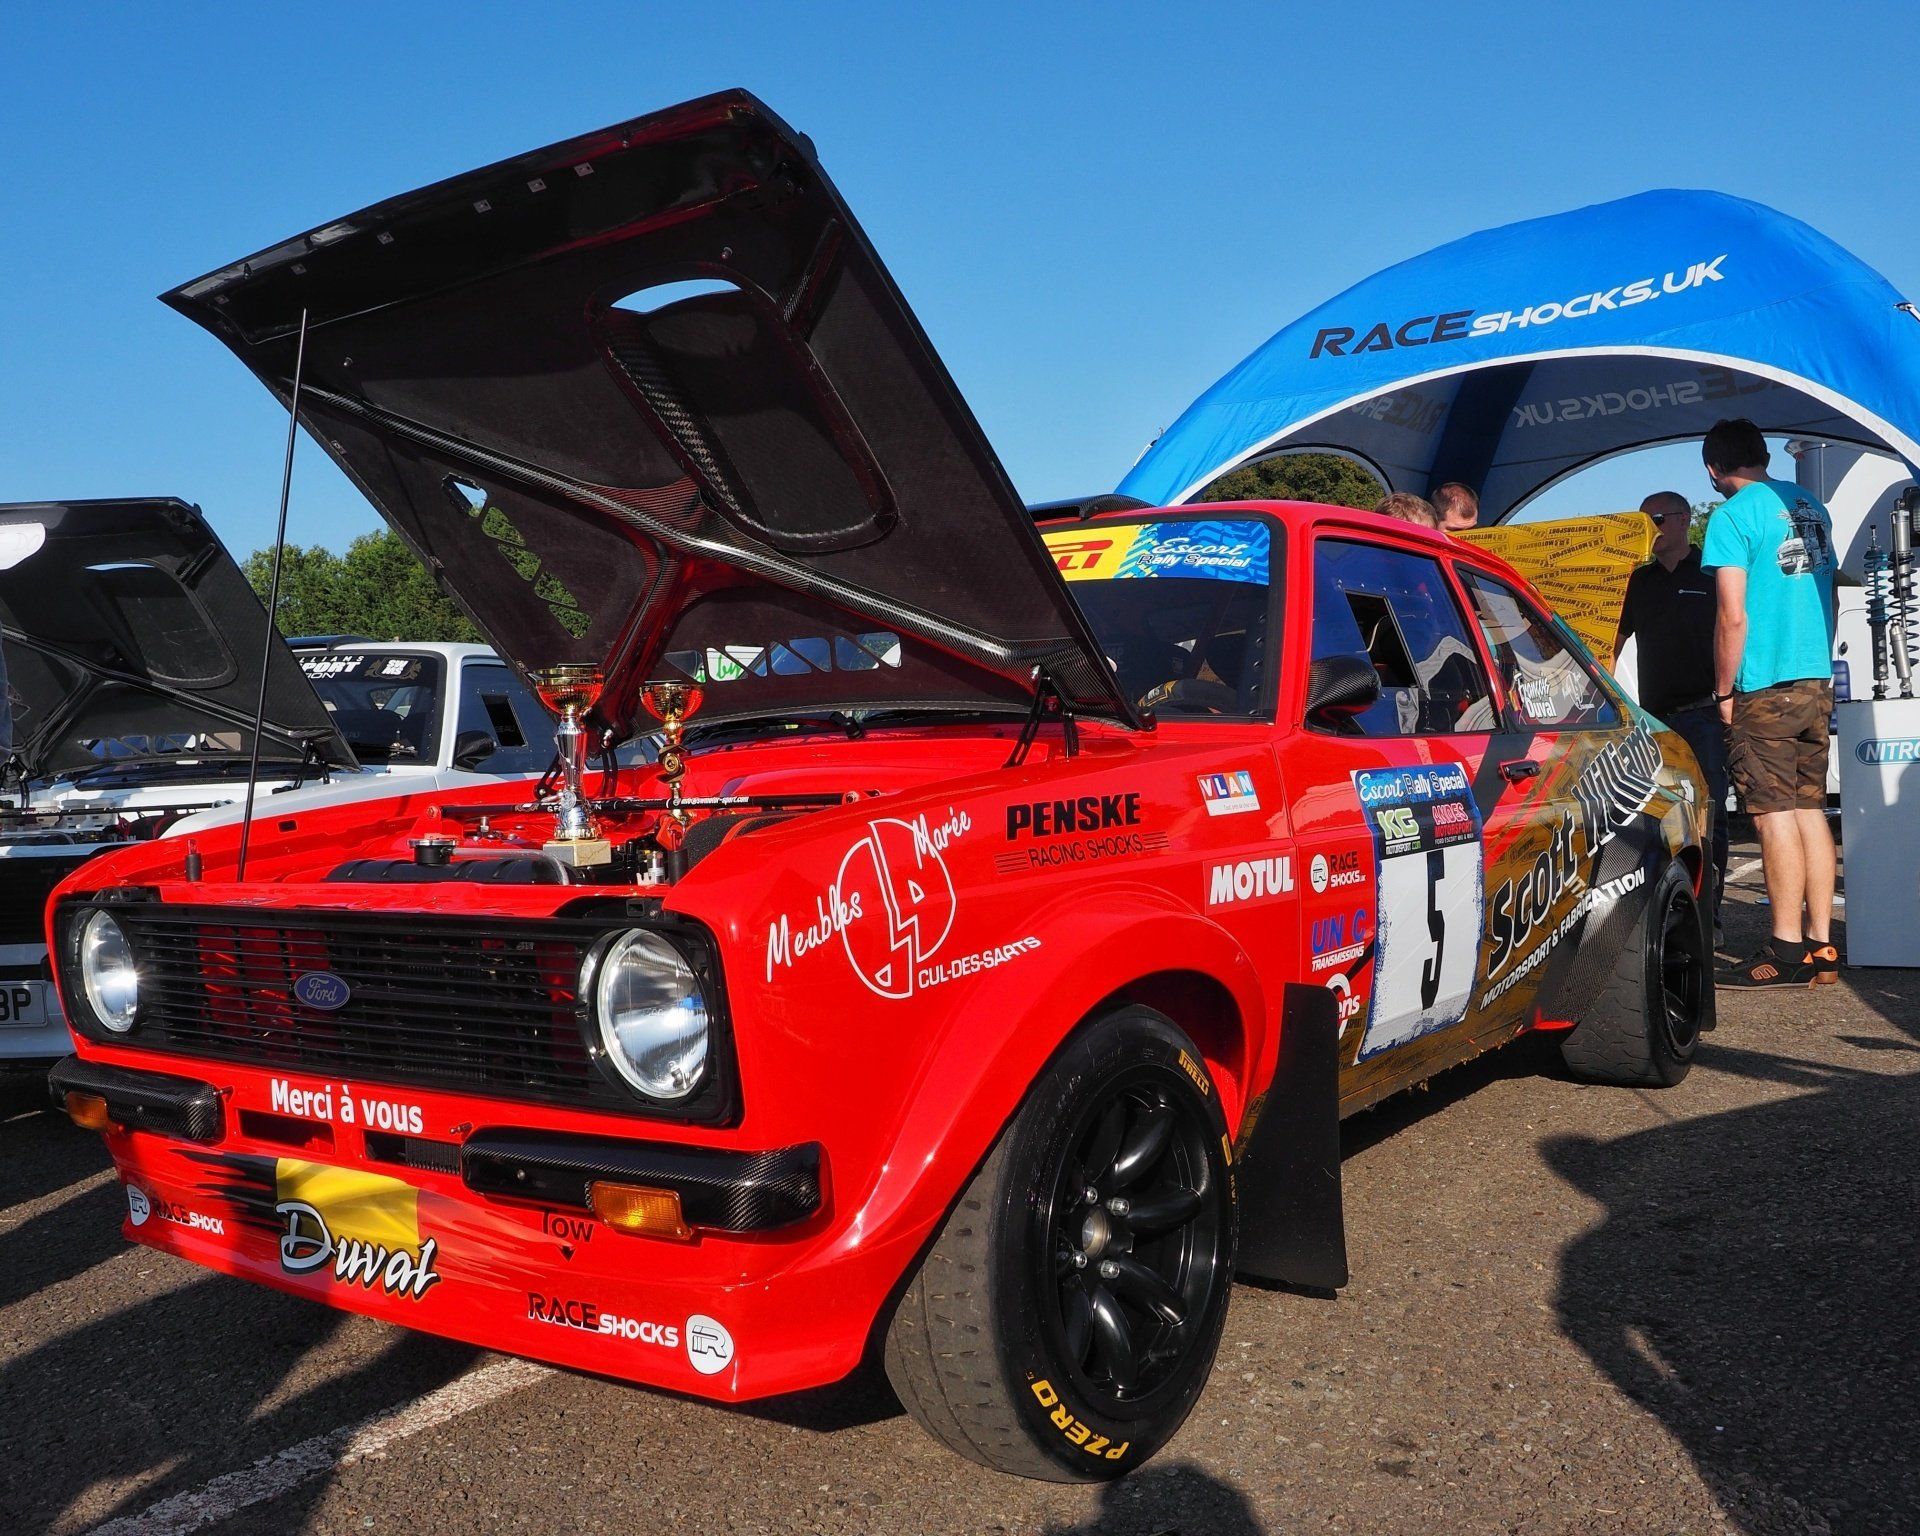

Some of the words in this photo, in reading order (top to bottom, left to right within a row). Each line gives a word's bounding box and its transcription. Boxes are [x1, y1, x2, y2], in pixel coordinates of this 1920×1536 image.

[1137, 555, 1184, 567] Rally
[1184, 555, 1251, 569] Special
[1152, 538, 1250, 555] Escort
[1525, 697, 1557, 718] Duval
[1200, 774, 1253, 797] VLAN
[1360, 772, 1404, 801] Escort
[1402, 774, 1431, 797] Rally
[1429, 771, 1466, 796] Special
[1006, 793, 1141, 841] PENSKE
[1377, 807, 1419, 840] KG
[1028, 841, 1086, 867] RACING
[1087, 834, 1143, 860] SHOCKS
[1330, 851, 1358, 872] RACE
[1209, 857, 1294, 905] MOTUL
[1487, 808, 1578, 980] Scott
[766, 884, 863, 983] Meubles
[1421, 849, 1445, 1011] 5
[1479, 941, 1551, 1011] MOTORSPORT
[1550, 929, 1559, 949] &
[1560, 867, 1645, 939] FABRICATION
[918, 936, 1041, 989] CUL-DES-SARTS
[1312, 946, 1365, 972] TRANSMISSIONS
[306, 978, 337, 1002] Ford
[1178, 1049, 1210, 1096] PIRELLI
[271, 1079, 333, 1120] Merci
[340, 1085, 354, 1123] à
[361, 1098, 423, 1134] vous
[276, 1201, 440, 1298] Duval
